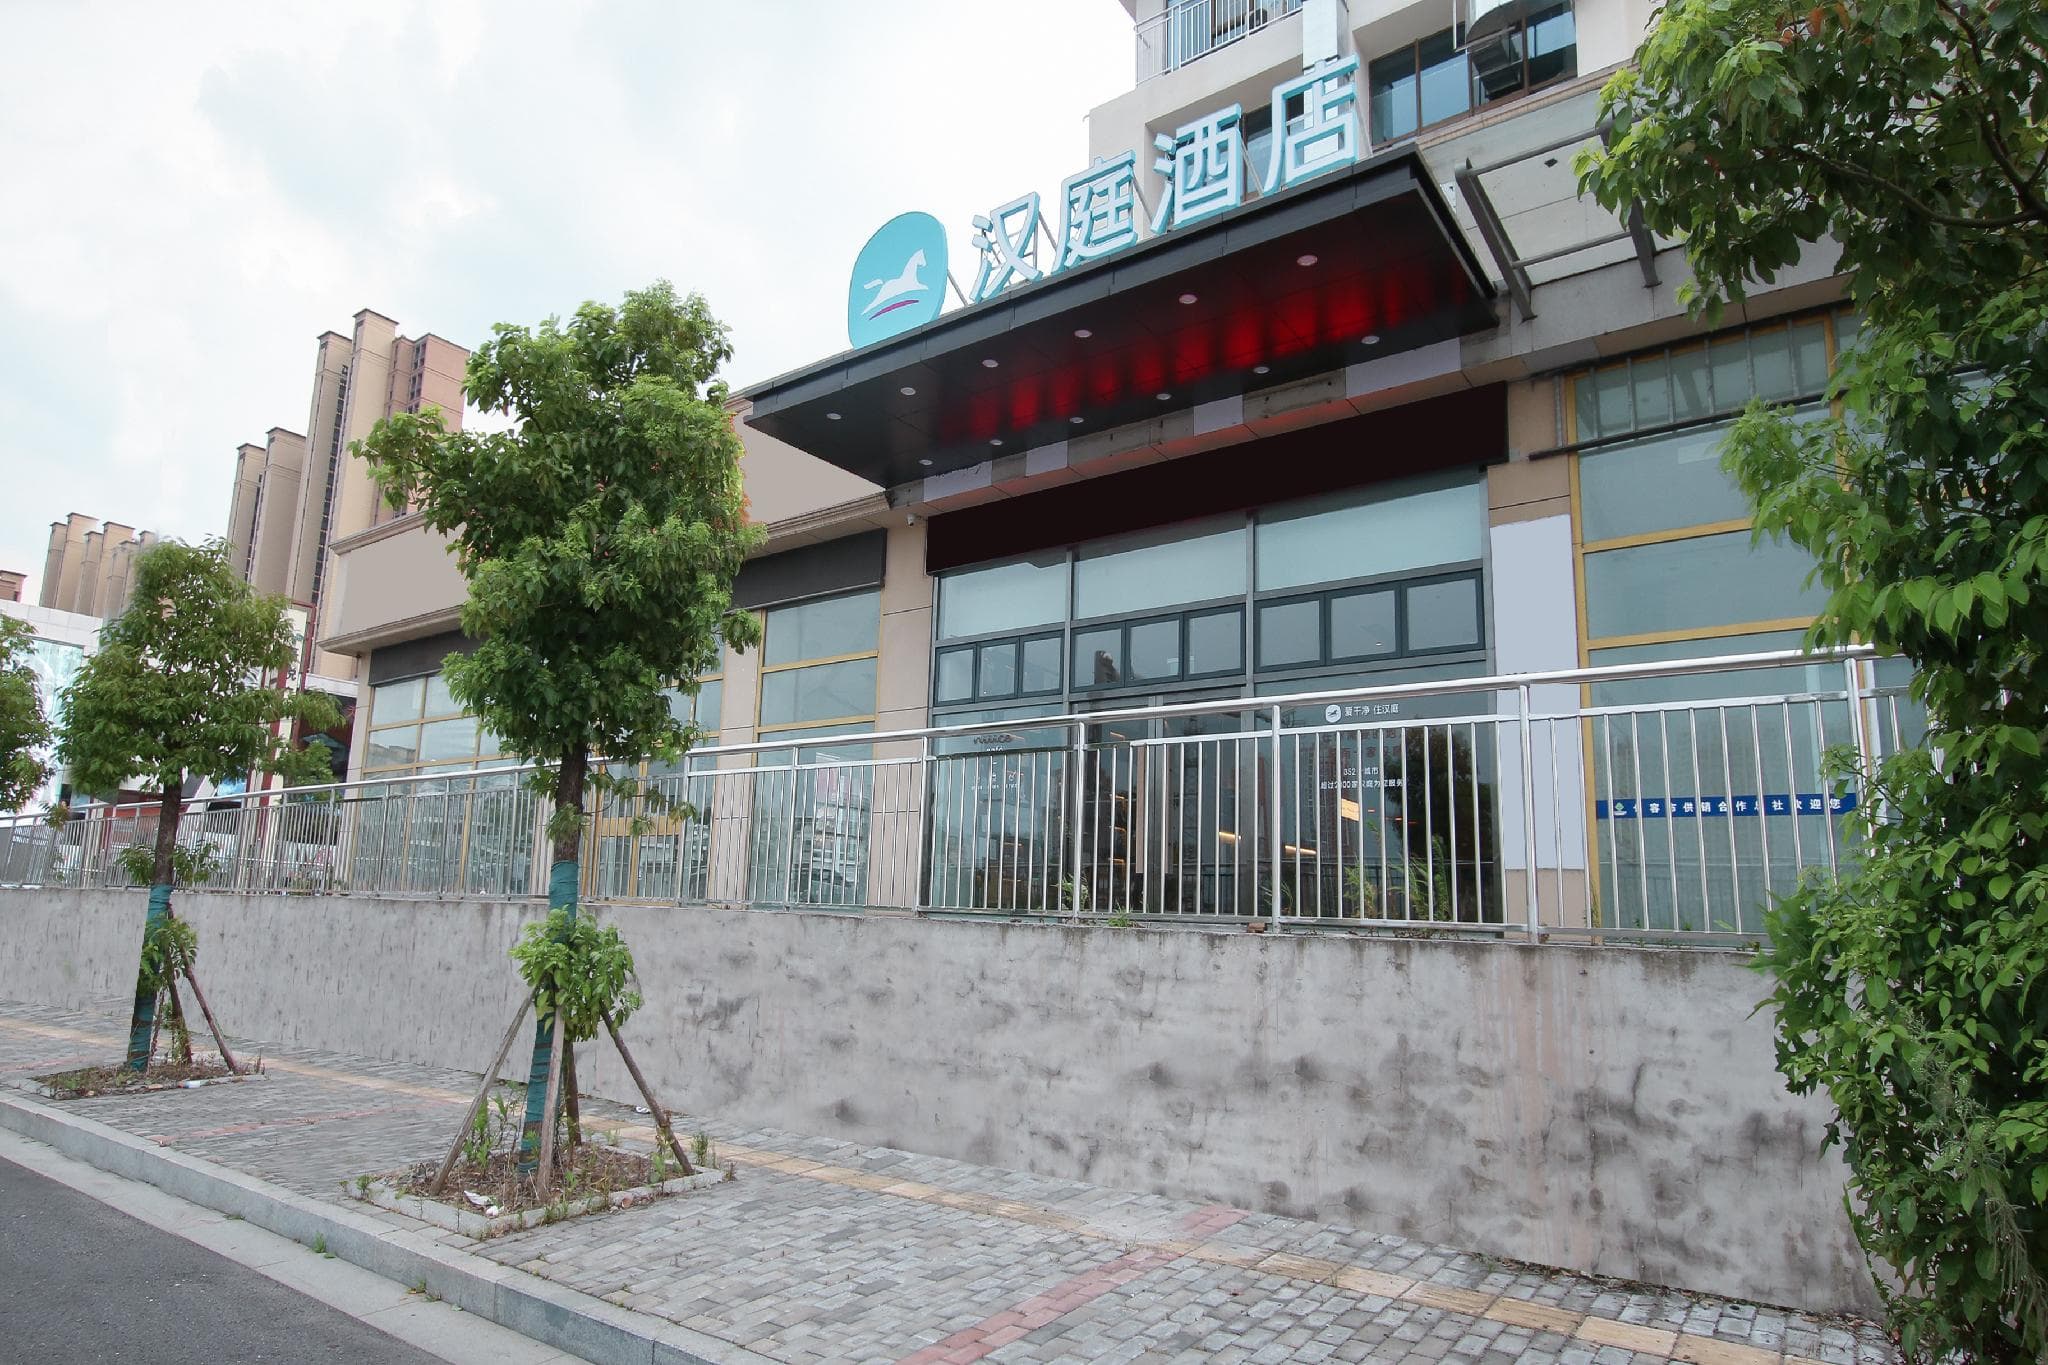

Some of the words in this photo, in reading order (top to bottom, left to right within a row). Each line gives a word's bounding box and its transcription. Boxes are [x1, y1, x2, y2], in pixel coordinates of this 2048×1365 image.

[968, 54, 1360, 303] 汉庭酒店
[1344, 706, 1370, 717] 爱干净
[1373, 703, 1399, 715] 住汉庭
[1343, 766, 1379, 776] 352城市
